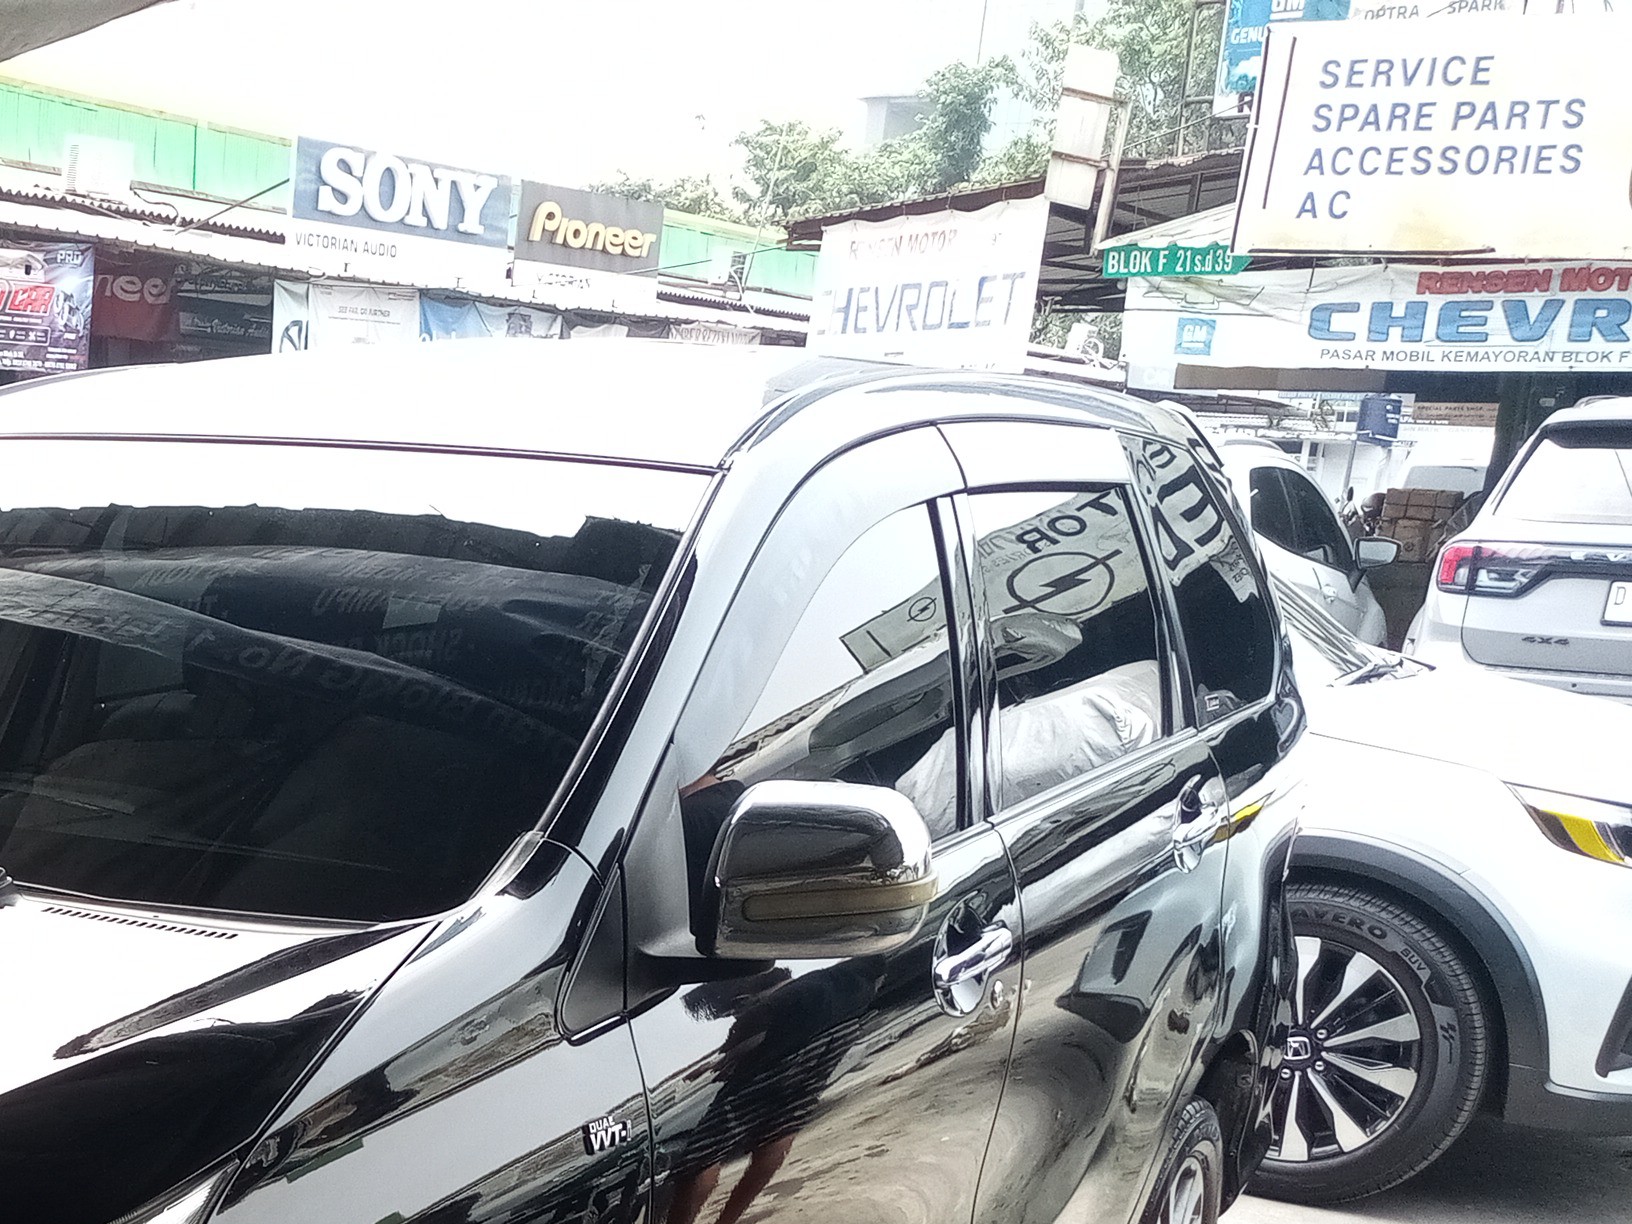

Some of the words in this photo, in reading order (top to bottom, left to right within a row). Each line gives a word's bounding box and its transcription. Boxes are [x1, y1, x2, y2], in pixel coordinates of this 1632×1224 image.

[1318, 55, 1495, 90] SERVICE
[1311, 101, 1438, 133] SPARE
[1450, 97, 1587, 132] PARTS
[1303, 143, 1584, 177] ACCESSORIES
[314, 146, 500, 236] SONY
[1295, 190, 1352, 220] AC
[295, 232, 359, 254] VICTORIAN
[362, 241, 399, 258] AUDIO
[527, 200, 658, 260] Pioneer
[1107, 251, 1153, 274] BLOK
[1157, 250, 1170, 272] F
[1175, 249, 1192, 271] 21
[1193, 249, 1214, 272] s.d
[1215, 246, 1234, 272] 39
[1416, 268, 1553, 295] RENSEN
[1181, 324, 1210, 342] GM
[1307, 298, 1632, 343] CHEVR
[1319, 347, 1378, 361] PASAR
[1380, 348, 1436, 363] MOBIL
[1440, 349, 1556, 364] KEMAYORAN
[1561, 350, 1613, 364] BLOK
[1618, 351, 1630, 364] F
[588, 1115, 616, 1133] DUAL
